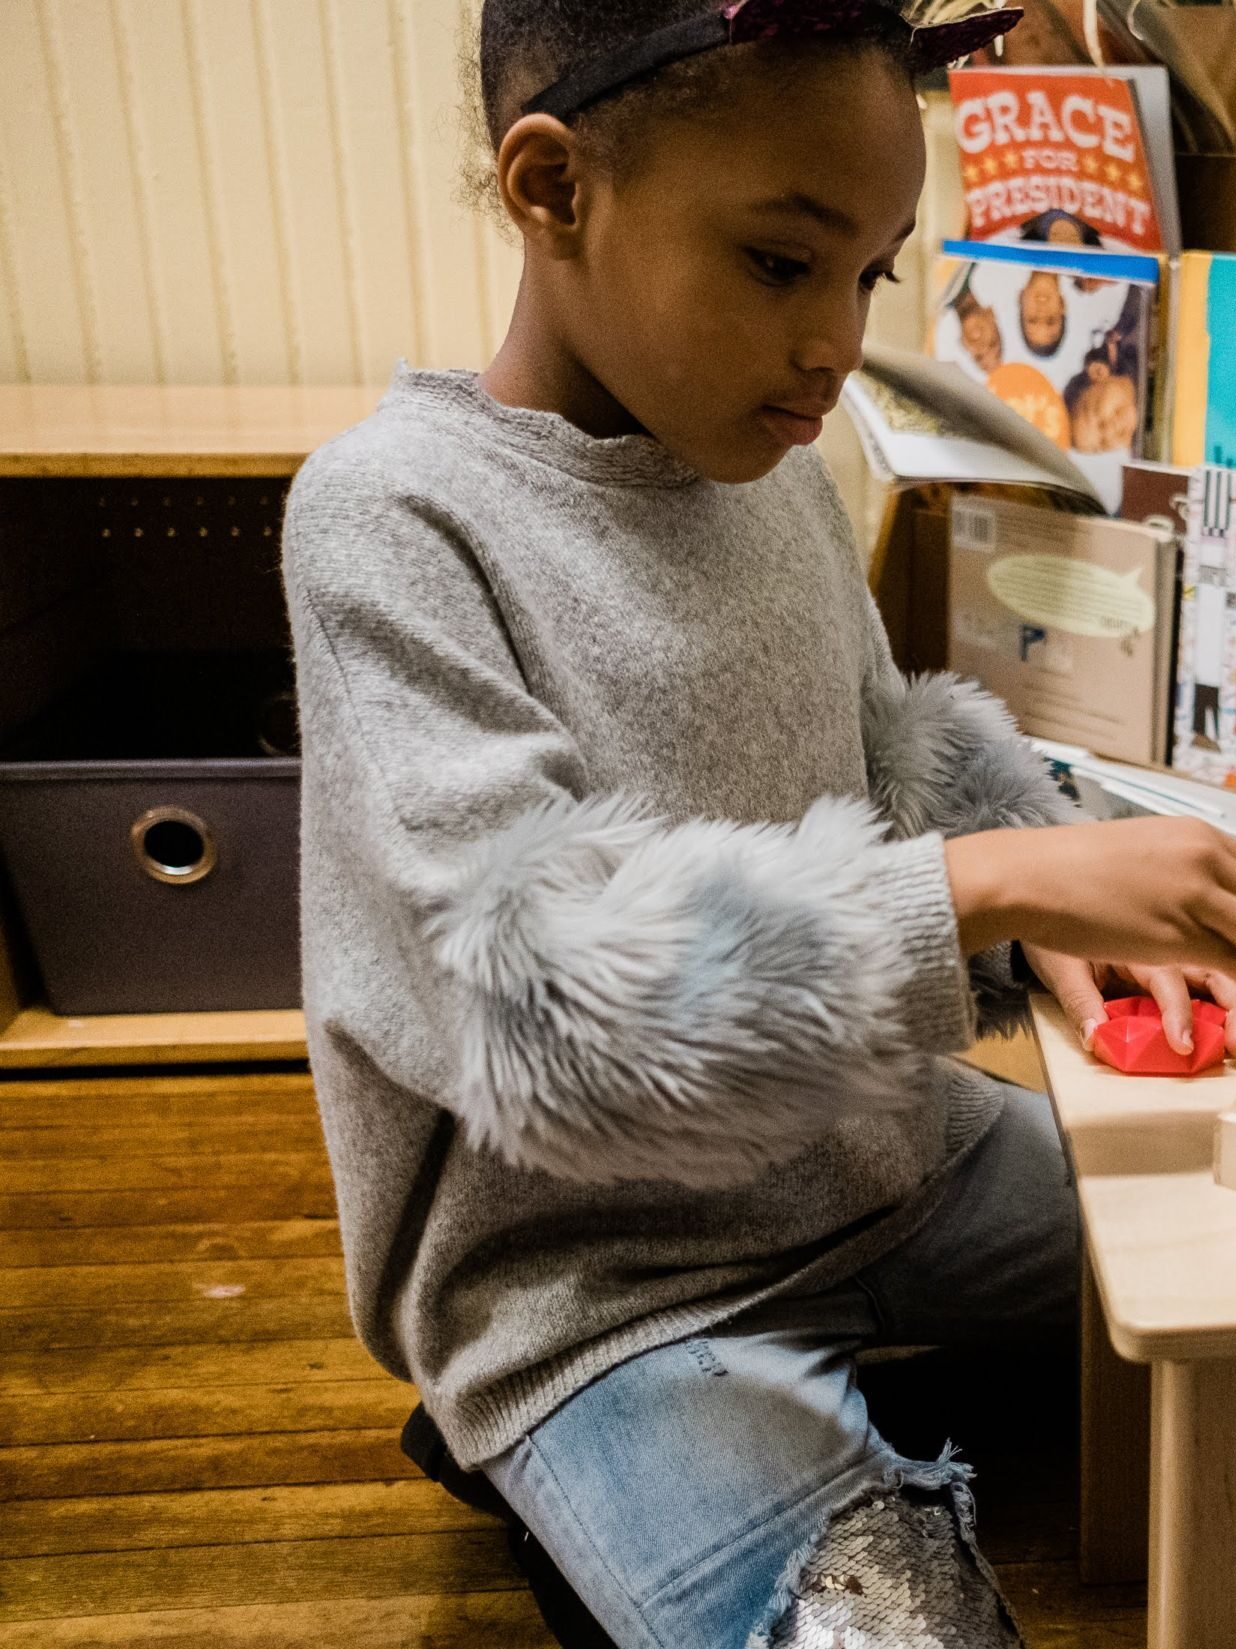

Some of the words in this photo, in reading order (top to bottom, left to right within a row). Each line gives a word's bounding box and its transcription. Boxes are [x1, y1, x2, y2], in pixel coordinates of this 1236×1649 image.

[956, 90, 1136, 163] GRACE
[1022, 150, 1080, 172] FOR
[966, 175, 1151, 235] PRESIDENT
